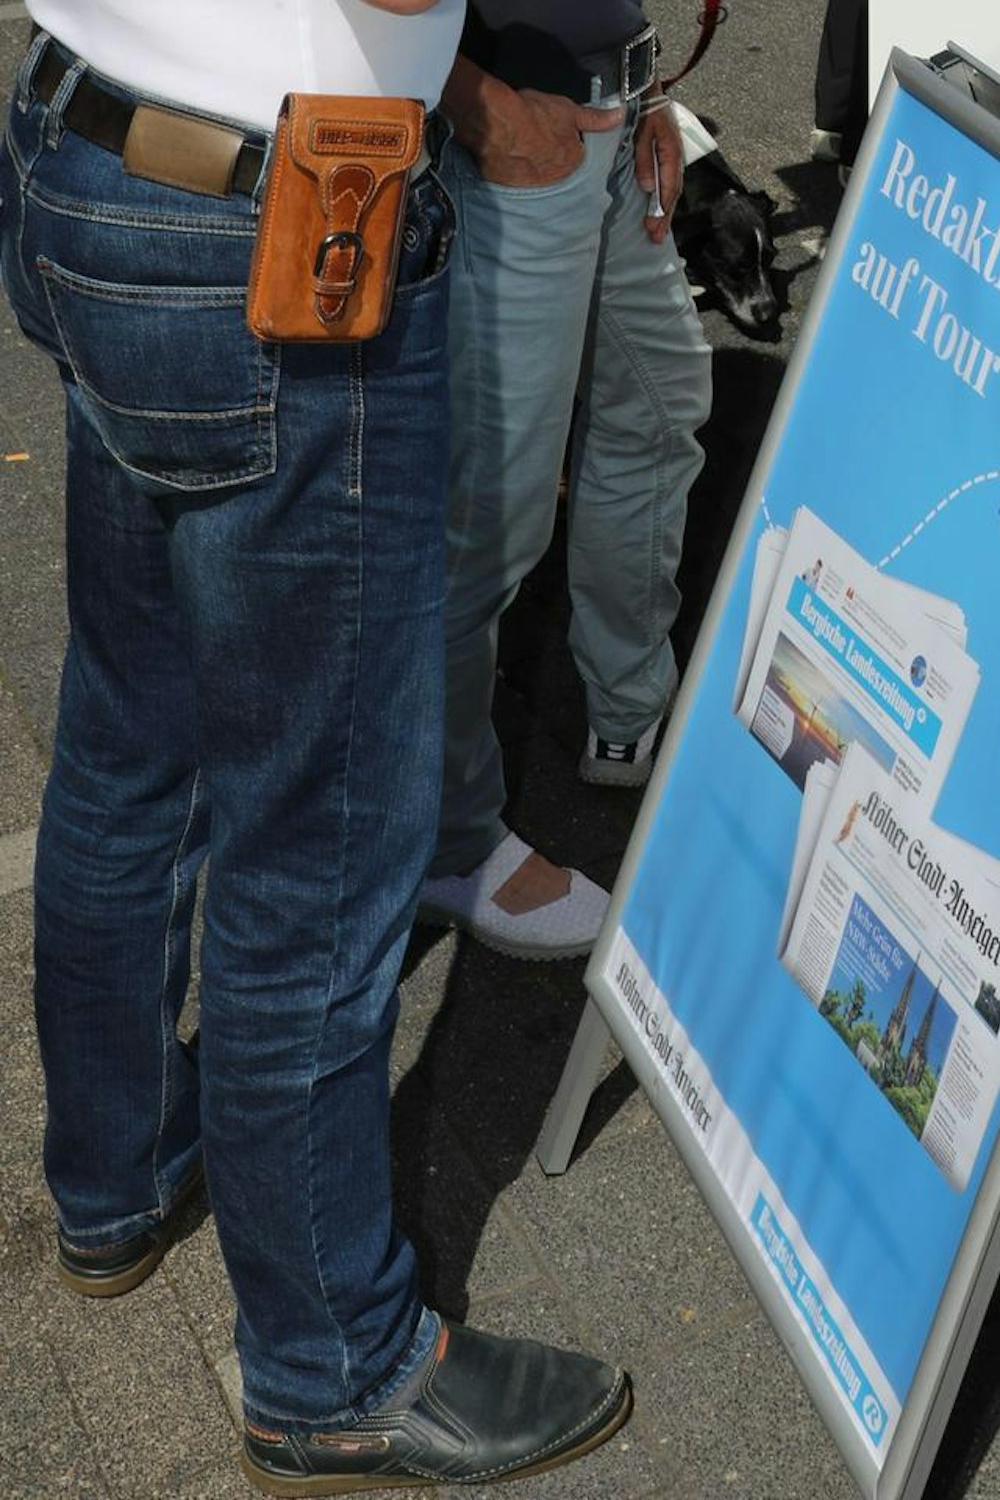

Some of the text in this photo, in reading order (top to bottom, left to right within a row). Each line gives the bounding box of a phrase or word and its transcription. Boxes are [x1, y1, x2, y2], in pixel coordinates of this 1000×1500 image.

[852, 242, 920, 320] auf
[800, 593, 846, 654] Bergische
[844, 638, 916, 731] Landeszeitung
[860, 791, 908, 854] Kölner
[616, 962, 649, 1024] Kölner
[758, 1204, 799, 1285] Bergische
[796, 1273, 862, 1402] Landeszeitung
